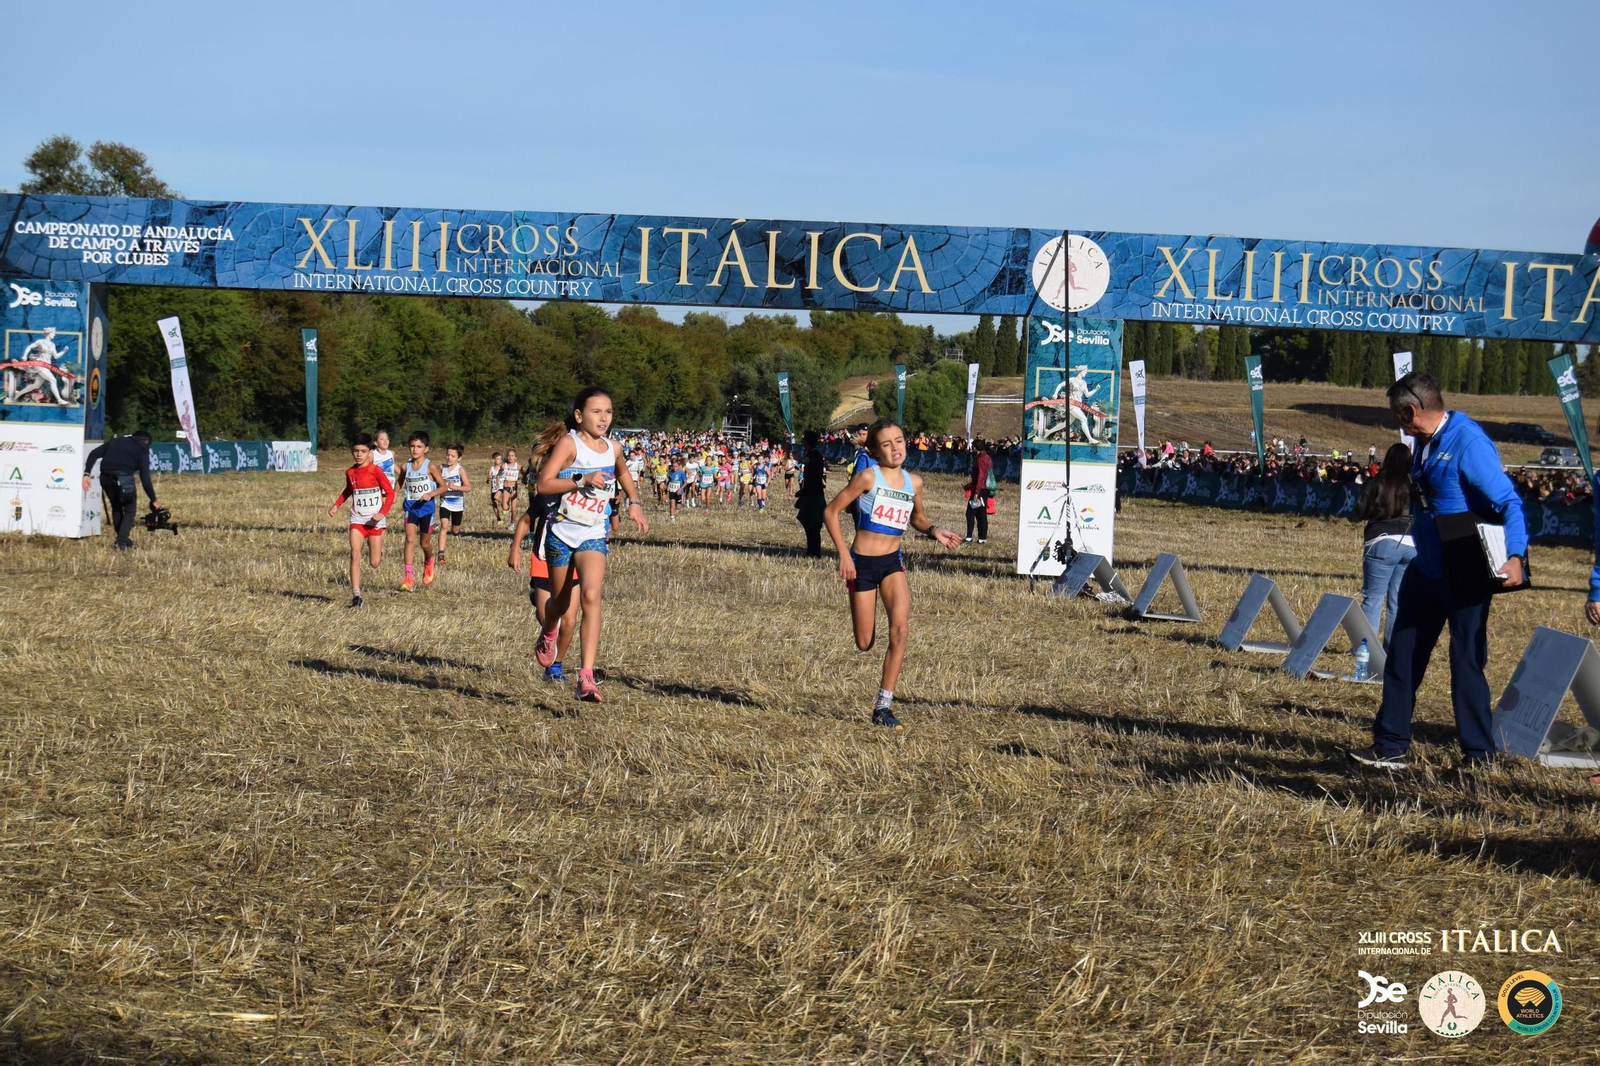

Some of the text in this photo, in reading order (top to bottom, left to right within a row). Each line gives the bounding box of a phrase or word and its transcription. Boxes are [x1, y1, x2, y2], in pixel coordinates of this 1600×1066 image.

[15, 221, 234, 241] CAMPEONATO DE ANDALUCÍA
[49, 236, 200, 253] DE CAMPO A TRAVÉS
[294, 217, 579, 273] XLIII CROSS
[82, 252, 169, 266] POR CLUBES
[635, 218, 936, 294] ITÁLICA
[456, 258, 624, 279] INTERNACIONAL
[1156, 246, 1314, 304] XLIII
[1318, 255, 1444, 291] CROSS
[44, 291, 77, 299] Diputación
[294, 273, 593, 297] INTERNATIONAL CROSS COUNTRY
[44, 298, 77, 308] Sevilla
[1317, 290, 1488, 313] INTERNACIONAL
[1152, 302, 1457, 331] INTERNATIONAL CROSS COUNTRY
[1077, 328, 1110, 336] Diputación
[1077, 335, 1110, 345] Sevilla
[409, 484, 429, 493] 4200
[356, 496, 380, 507] 4117
[566, 491, 606, 514] 4426
[873, 504, 910, 525] 4415
[1559, 523, 1580, 536] Sevilla
